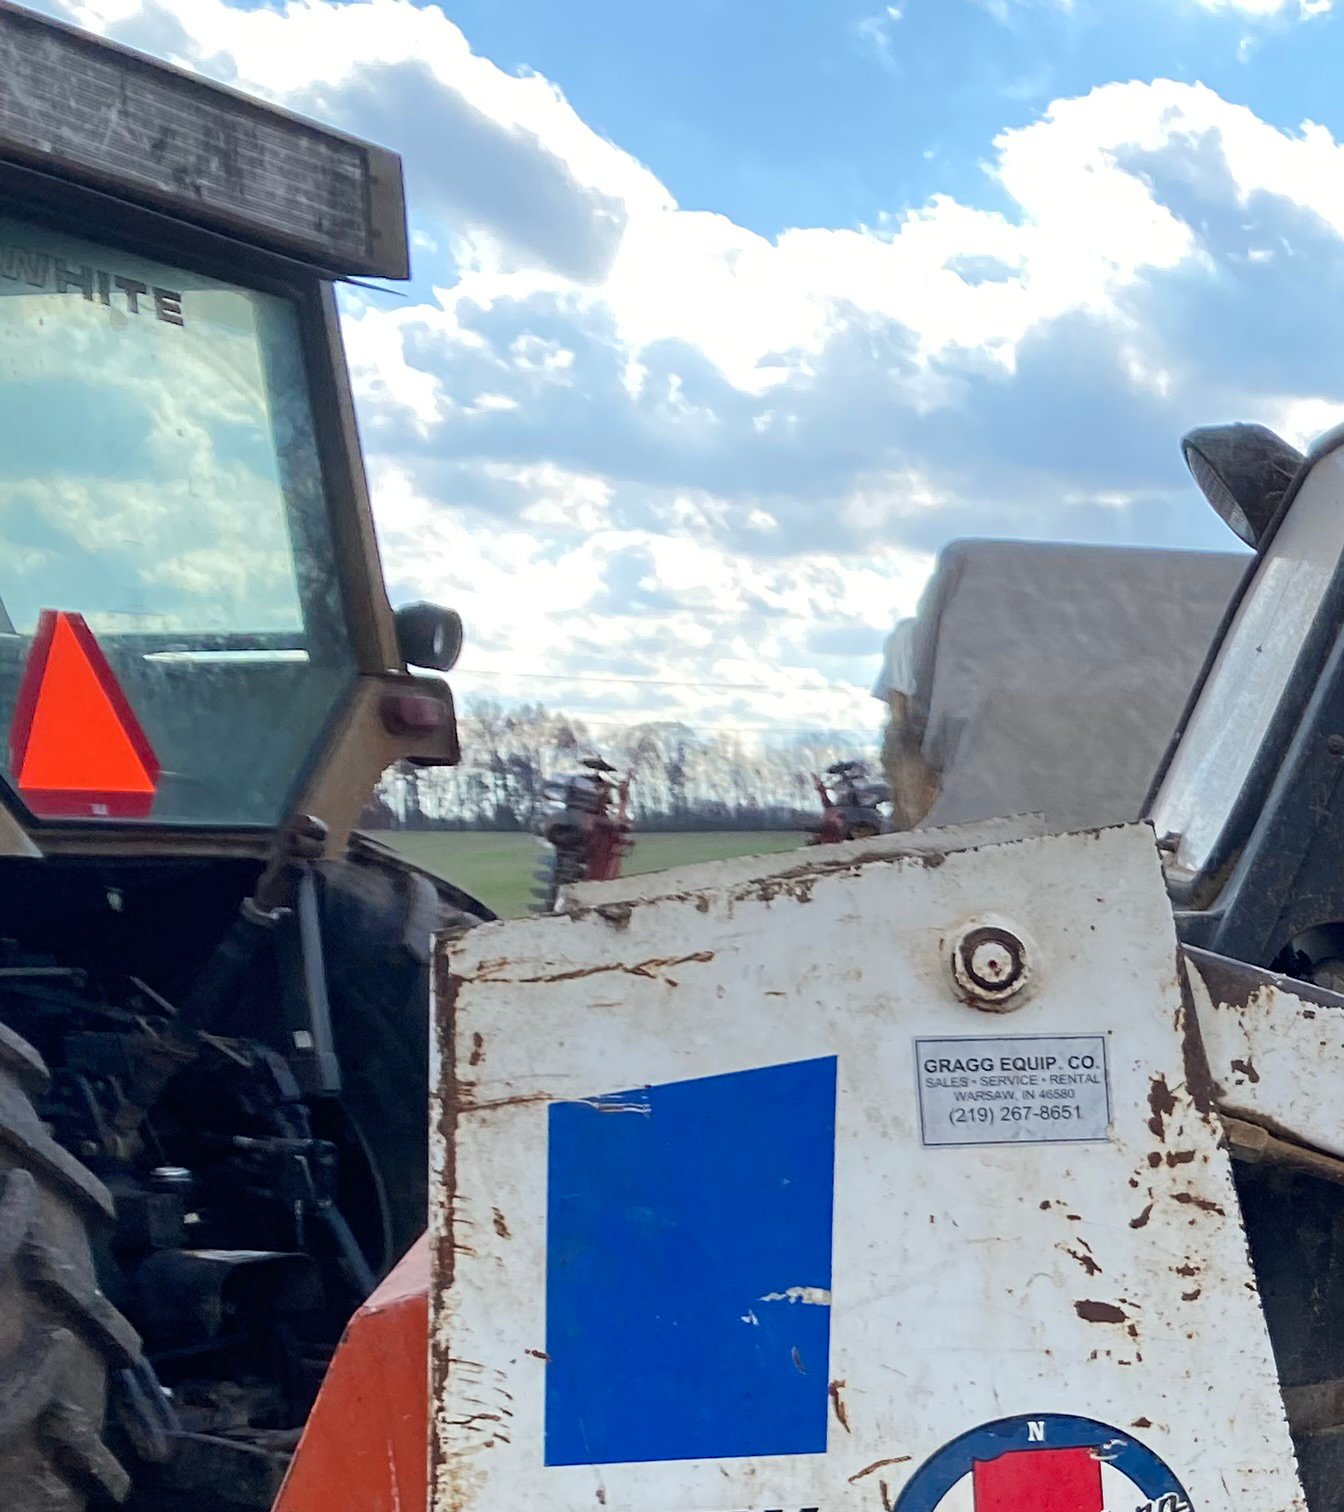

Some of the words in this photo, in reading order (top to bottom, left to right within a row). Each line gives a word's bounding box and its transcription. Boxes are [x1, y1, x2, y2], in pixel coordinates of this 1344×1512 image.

[0, 246, 184, 327] WHITE
[923, 1057, 994, 1074] GRAGG
[1000, 1056, 1063, 1071] EQUIP.
[1068, 1055, 1100, 1070] CO.
[925, 1076, 969, 1088] SALES
[980, 1075, 1038, 1086] SERVICE
[1050, 1074, 1100, 1085] RENTAL
[1022, 1090, 1035, 1100] IN
[949, 1107, 994, 1125] (219)
[1000, 1105, 1083, 1121] 267-8651
[1027, 1421, 1045, 1441] N
